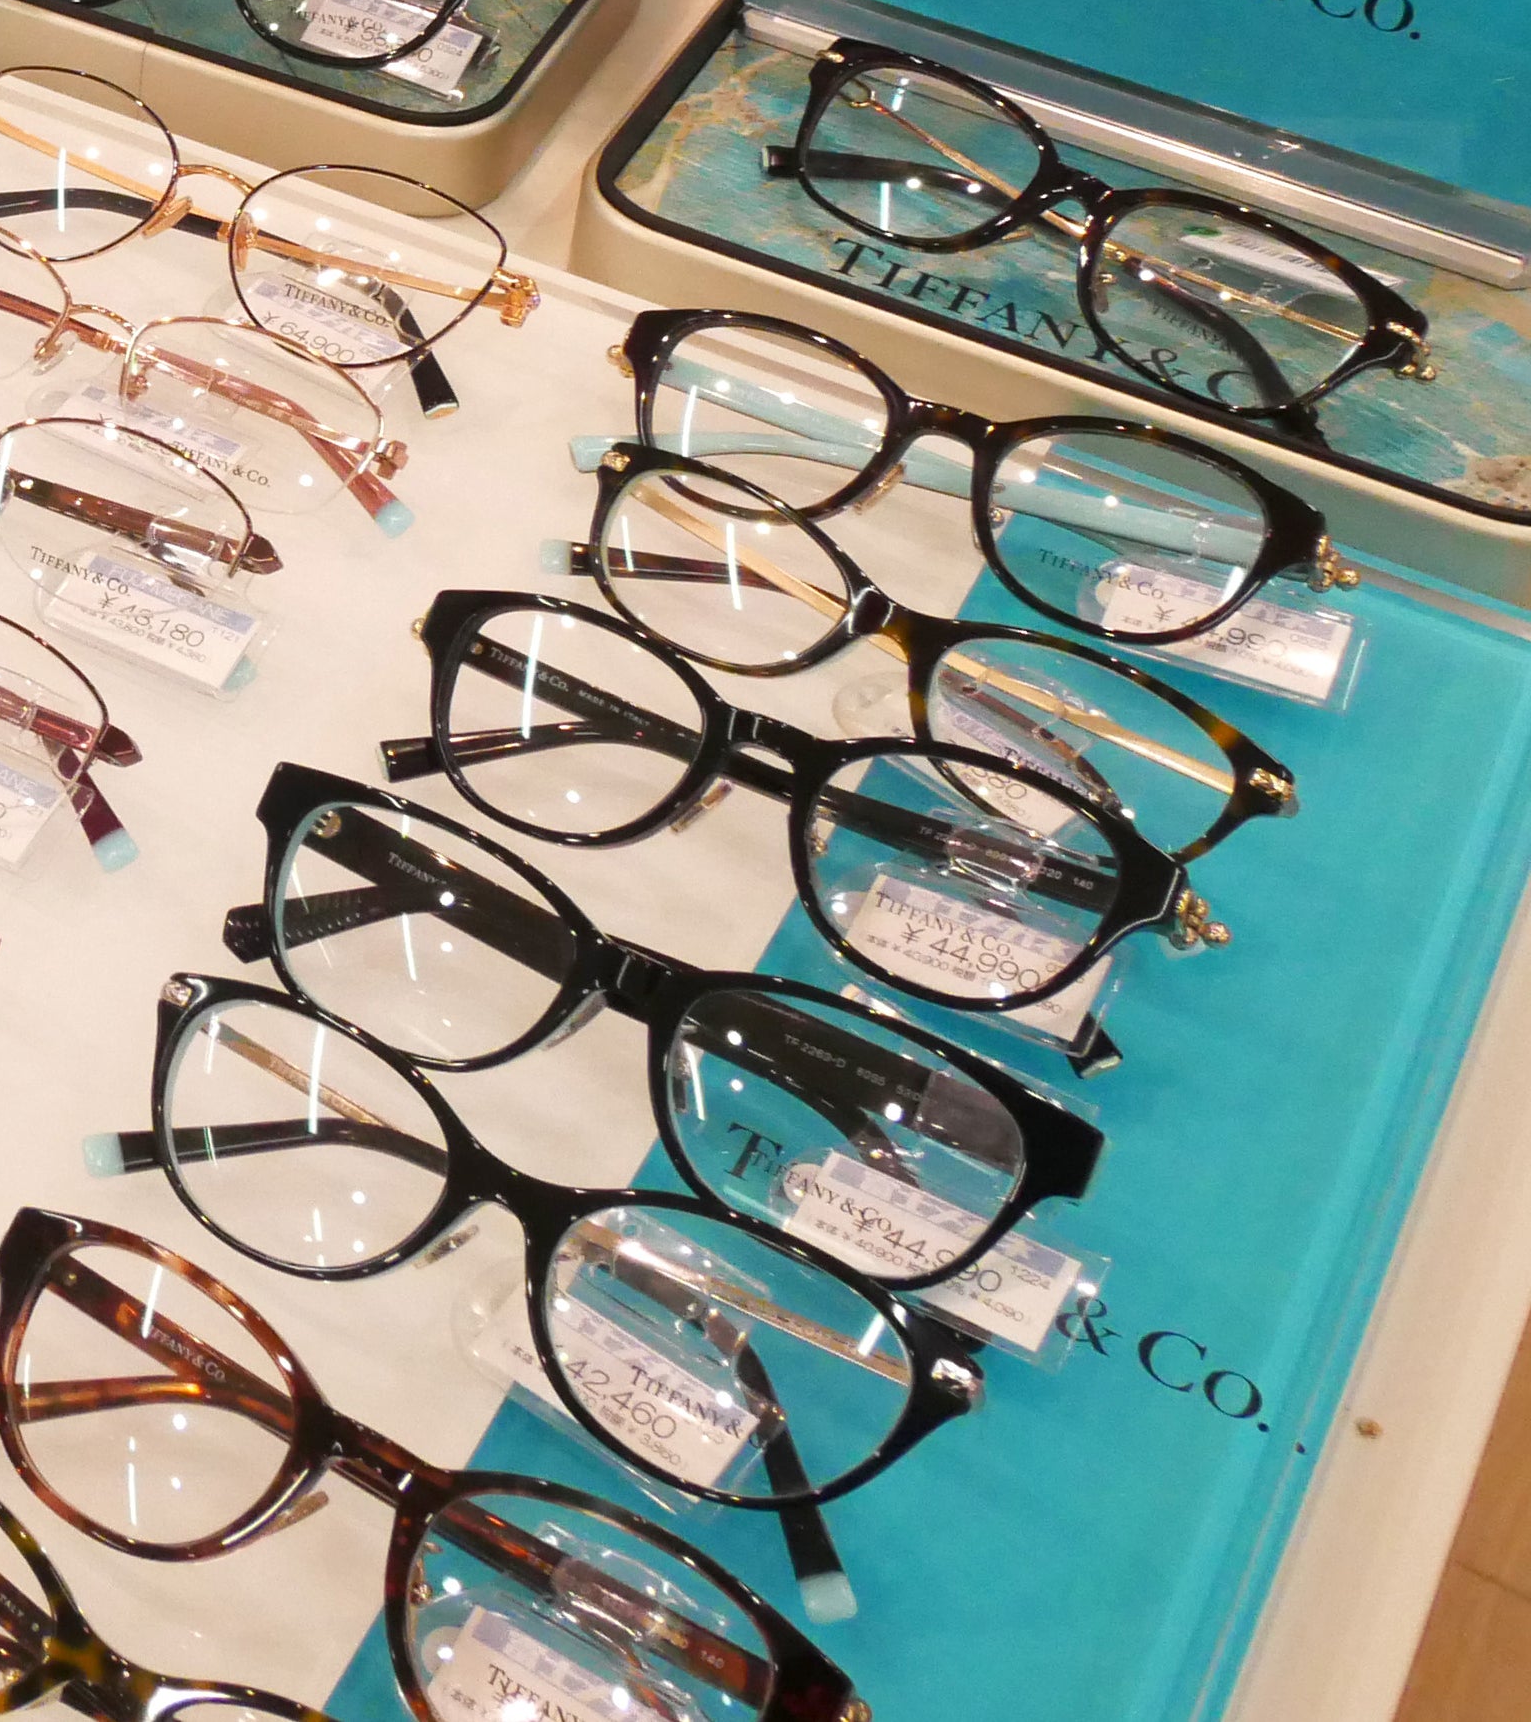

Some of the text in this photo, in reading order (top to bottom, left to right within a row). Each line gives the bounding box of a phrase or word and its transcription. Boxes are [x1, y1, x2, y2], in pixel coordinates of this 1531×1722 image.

[284, 283, 348, 314] TIFFANY
[30, 544, 90, 581] TIFFANY
[874, 891, 955, 937] TIFFANY
[749, 1146, 843, 1207] TIFFANY
[629, 1364, 726, 1431] TIFFANY
